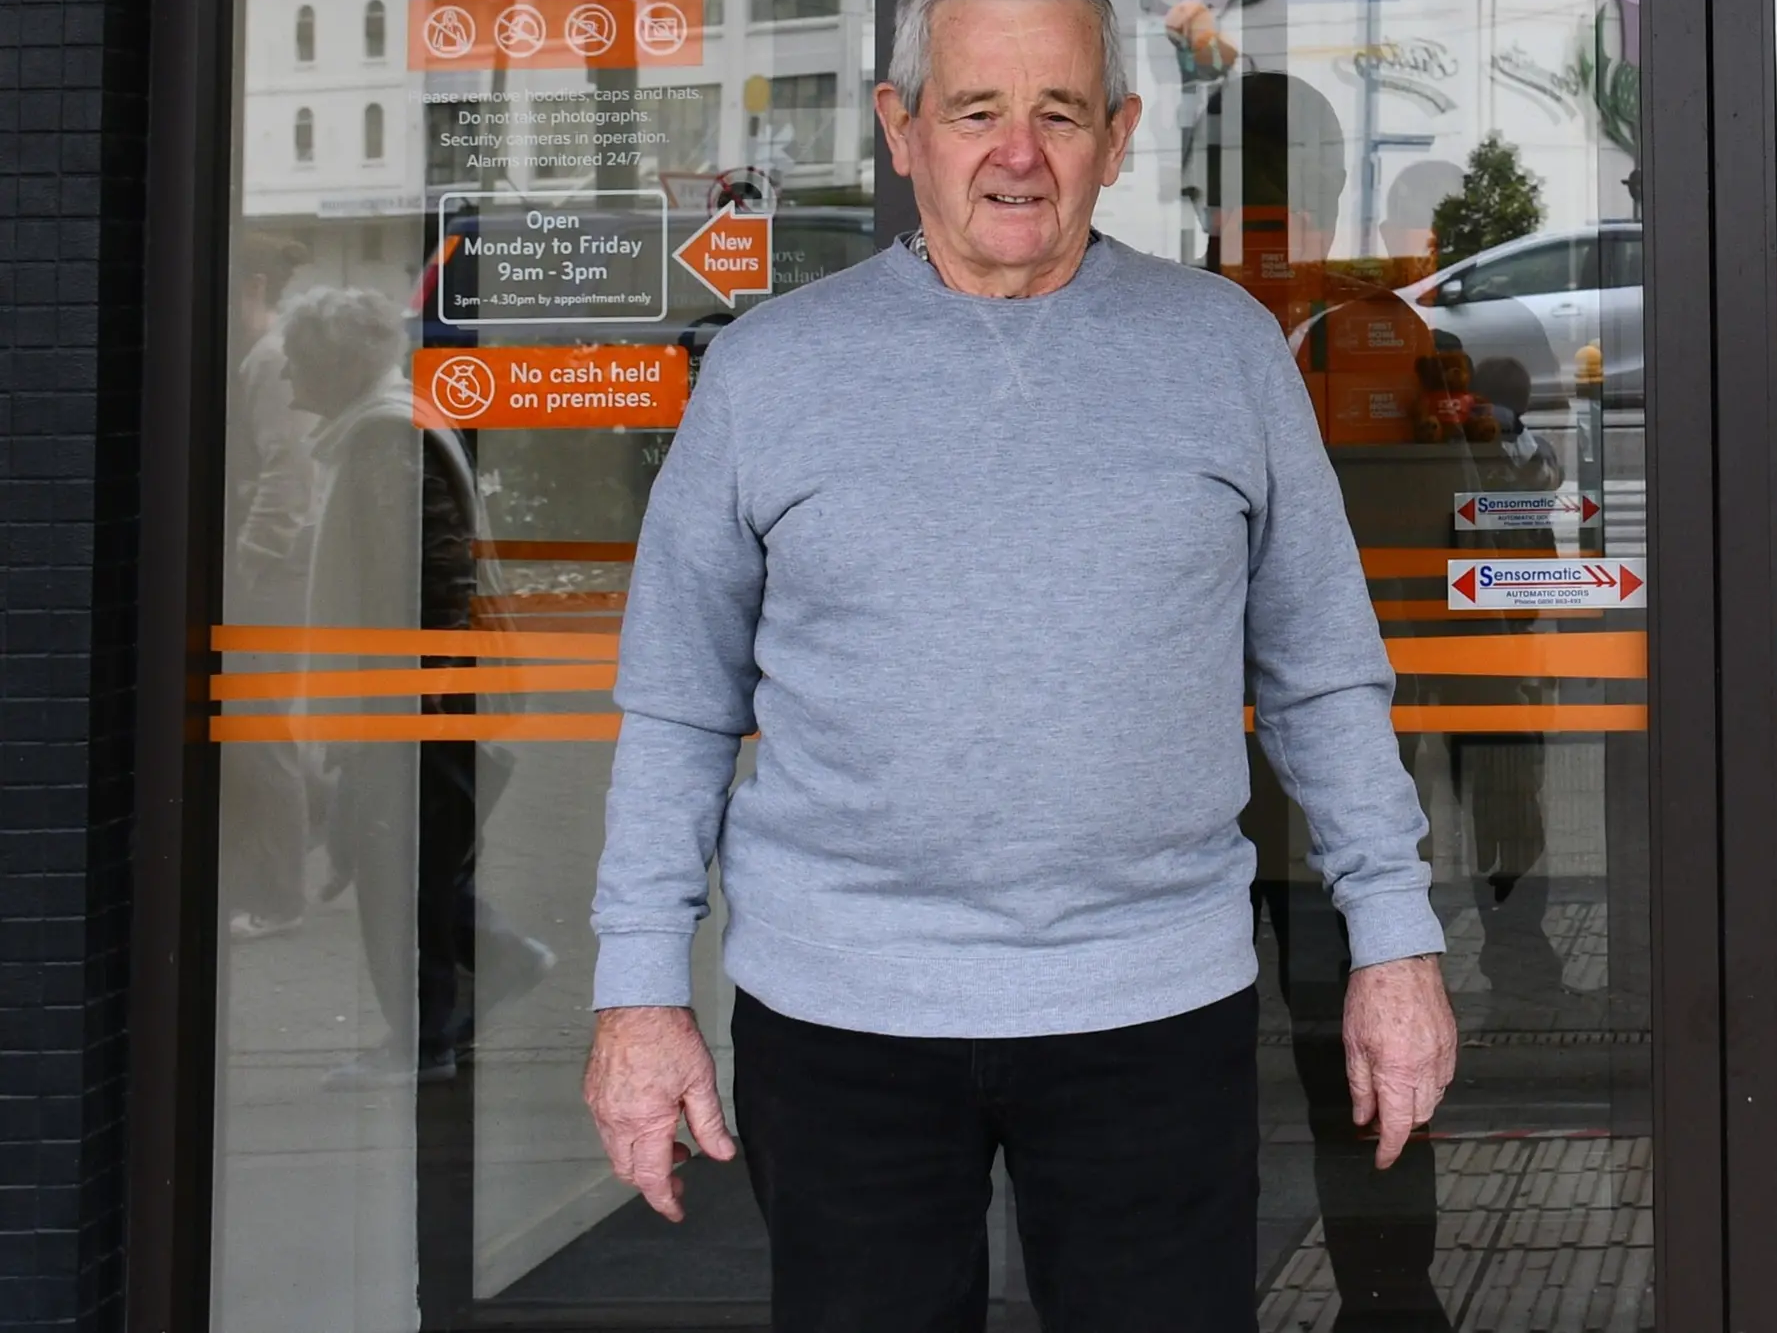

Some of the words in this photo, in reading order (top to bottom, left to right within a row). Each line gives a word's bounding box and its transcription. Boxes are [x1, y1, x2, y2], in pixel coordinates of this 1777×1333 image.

[409, 91, 459, 104] Please
[462, 92, 520, 103] remove
[524, 89, 589, 103] hoodies,
[594, 91, 629, 105] caps
[634, 88, 663, 100] and
[667, 87, 703, 100] hats.
[459, 111, 481, 125] Do
[486, 112, 510, 124] not
[514, 112, 546, 124] take
[551, 109, 651, 126] photographs.
[440, 133, 502, 148] Security
[506, 133, 570, 145] cameras
[575, 132, 588, 144] in
[593, 132, 669, 147] operation.
[467, 154, 519, 168] Alarms
[524, 153, 601, 166] monitored
[527, 211, 579, 234] Open
[465, 236, 545, 259] Monday
[552, 238, 572, 254] to
[580, 235, 642, 257] Friday
[711, 232, 752, 251] New
[704, 254, 759, 271] hours
[498, 262, 543, 281] 9am
[561, 261, 607, 284] 3pm
[454, 295, 480, 307] 3pm
[490, 294, 535, 306] 4.30pm
[538, 294, 551, 306] by
[554, 293, 625, 306] appointment
[628, 292, 651, 305] only
[511, 363, 542, 383] No
[550, 362, 601, 383] cash
[611, 361, 660, 382] held
[510, 393, 537, 408] on
[547, 388, 657, 413] premises.
[1478, 496, 1554, 513] Sensormatic
[1480, 565, 1581, 587] Sensormatic
[1506, 590, 1556, 598] AUTOMATIC
[1558, 589, 1589, 597] DOORS
